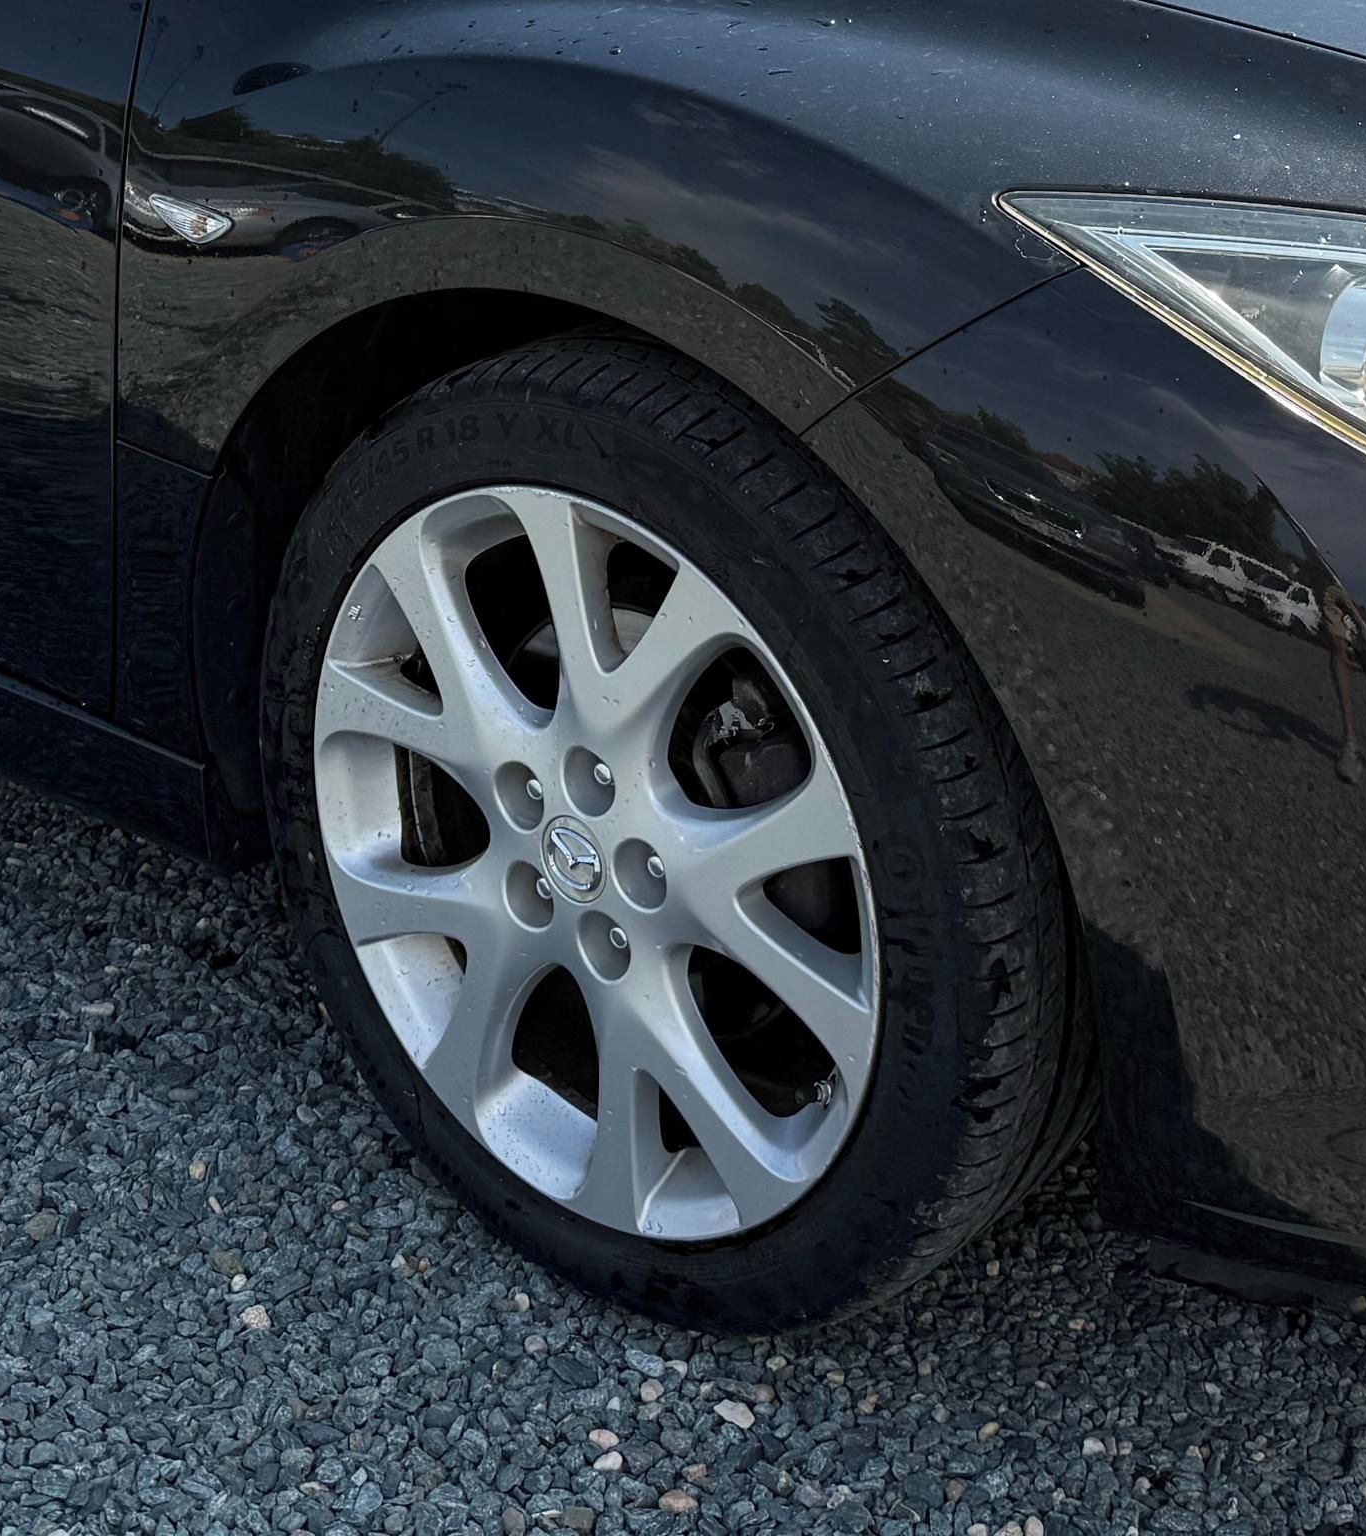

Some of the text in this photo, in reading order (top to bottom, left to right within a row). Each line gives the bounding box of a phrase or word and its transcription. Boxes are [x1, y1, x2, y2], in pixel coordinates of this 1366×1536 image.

[417, 425, 435, 455] R
[442, 414, 482, 445] 18
[494, 411, 519, 439] Y
[534, 413, 582, 451] XL
